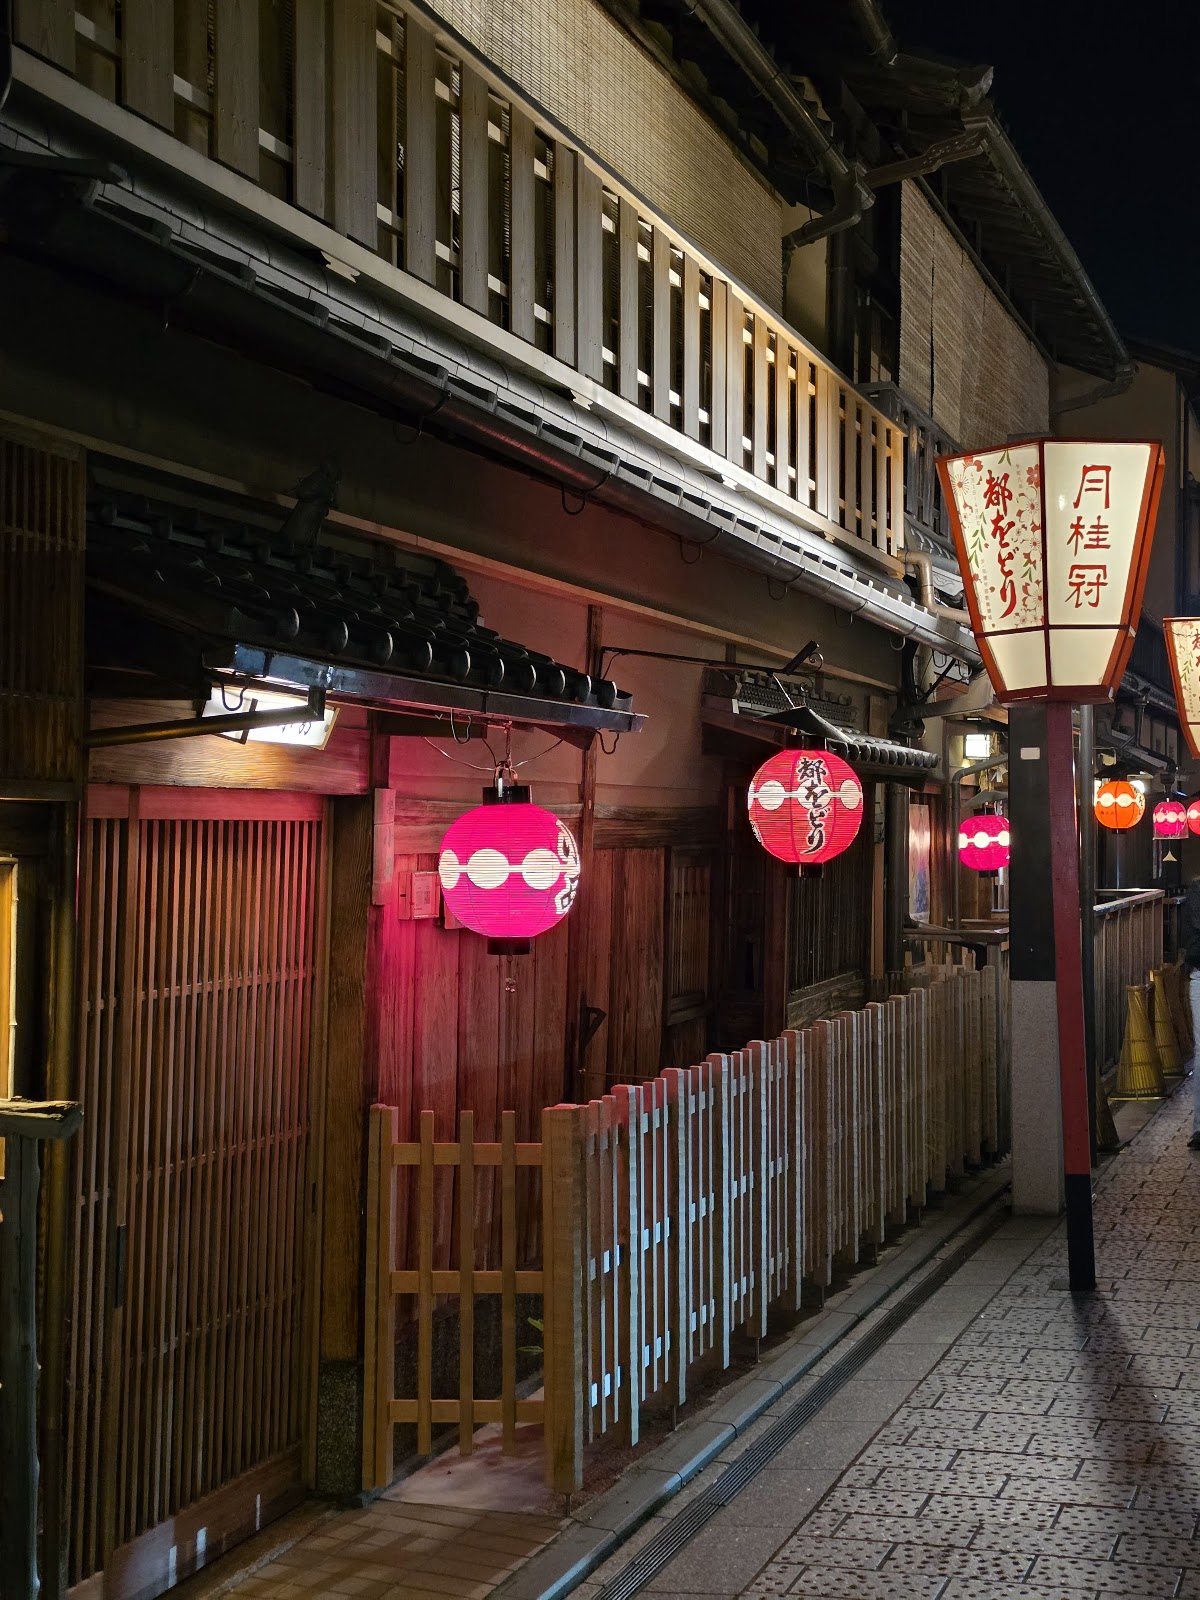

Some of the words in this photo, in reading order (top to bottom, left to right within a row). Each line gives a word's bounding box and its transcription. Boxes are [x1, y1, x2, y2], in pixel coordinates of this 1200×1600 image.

[983, 469, 1019, 619] 都をどり
[1065, 464, 1112, 608] 月桂冠
[797, 757, 831, 854] 都をどり
